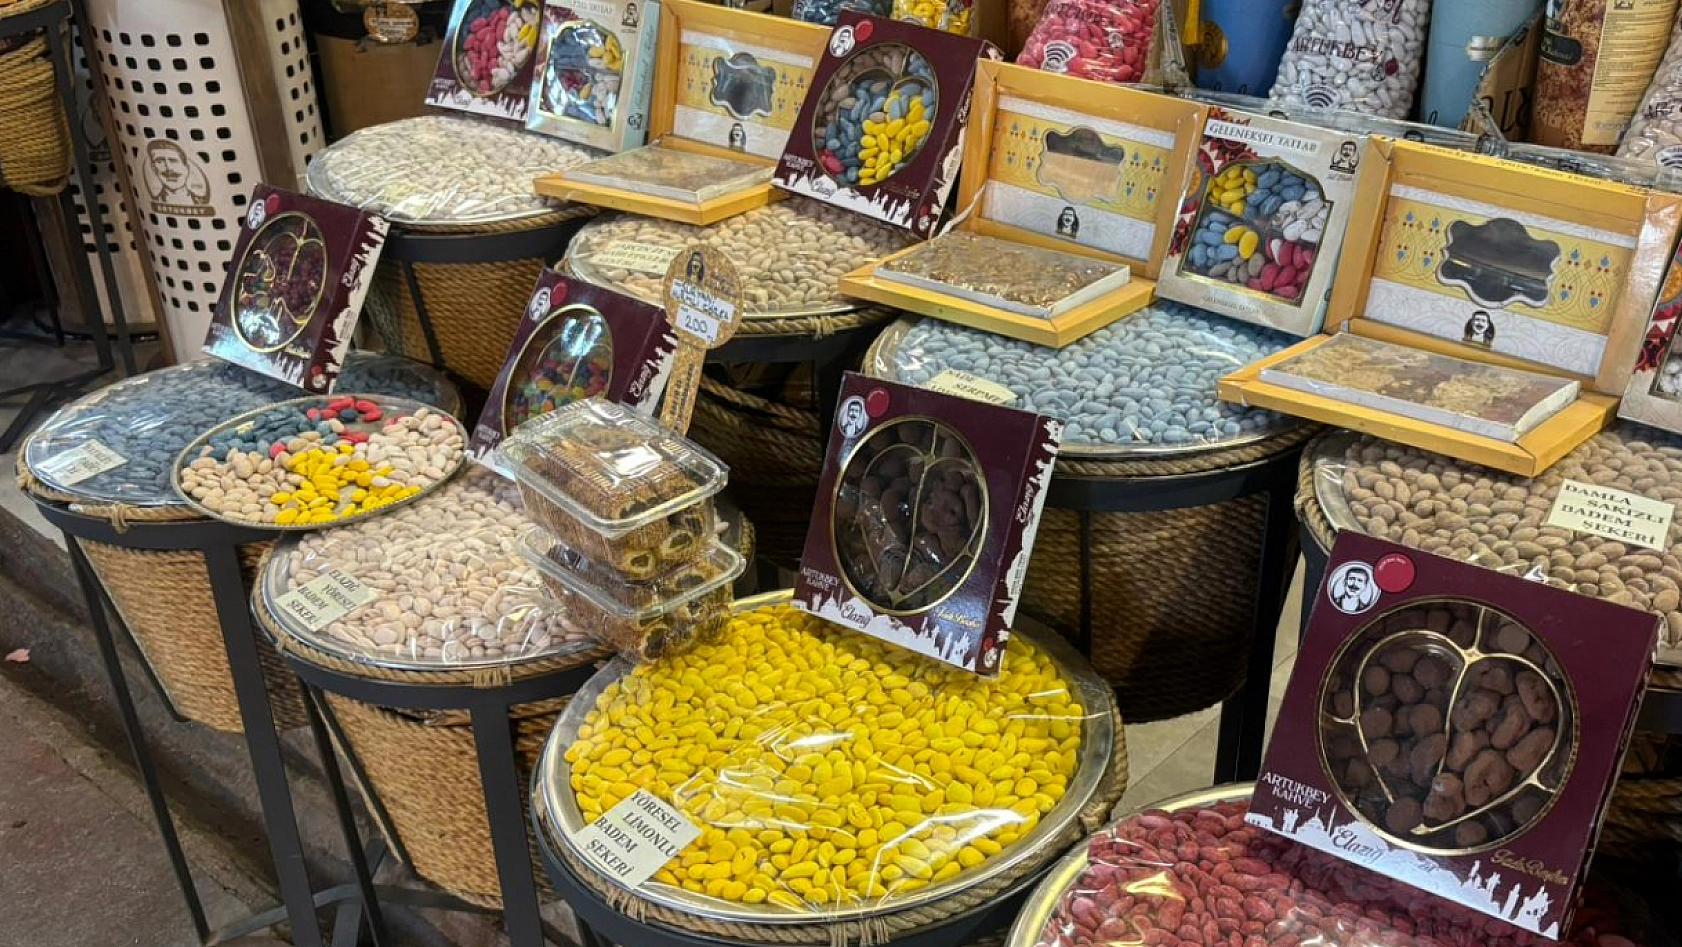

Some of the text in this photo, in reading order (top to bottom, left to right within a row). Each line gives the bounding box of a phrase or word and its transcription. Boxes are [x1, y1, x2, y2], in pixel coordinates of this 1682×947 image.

[685, 314, 708, 334] 200
[1565, 484, 1631, 505] DAMLA
[1561, 504, 1631, 526] BADEM
[297, 586, 328, 610] BADEM
[1262, 772, 1331, 805] ARTUKBEY
[1272, 785, 1314, 810] KAHVE
[632, 791, 681, 832] YÖRESEL
[594, 816, 638, 853] BADEM
[623, 812, 679, 857] LİMONLU
[587, 839, 635, 877] ŞEKERİ
